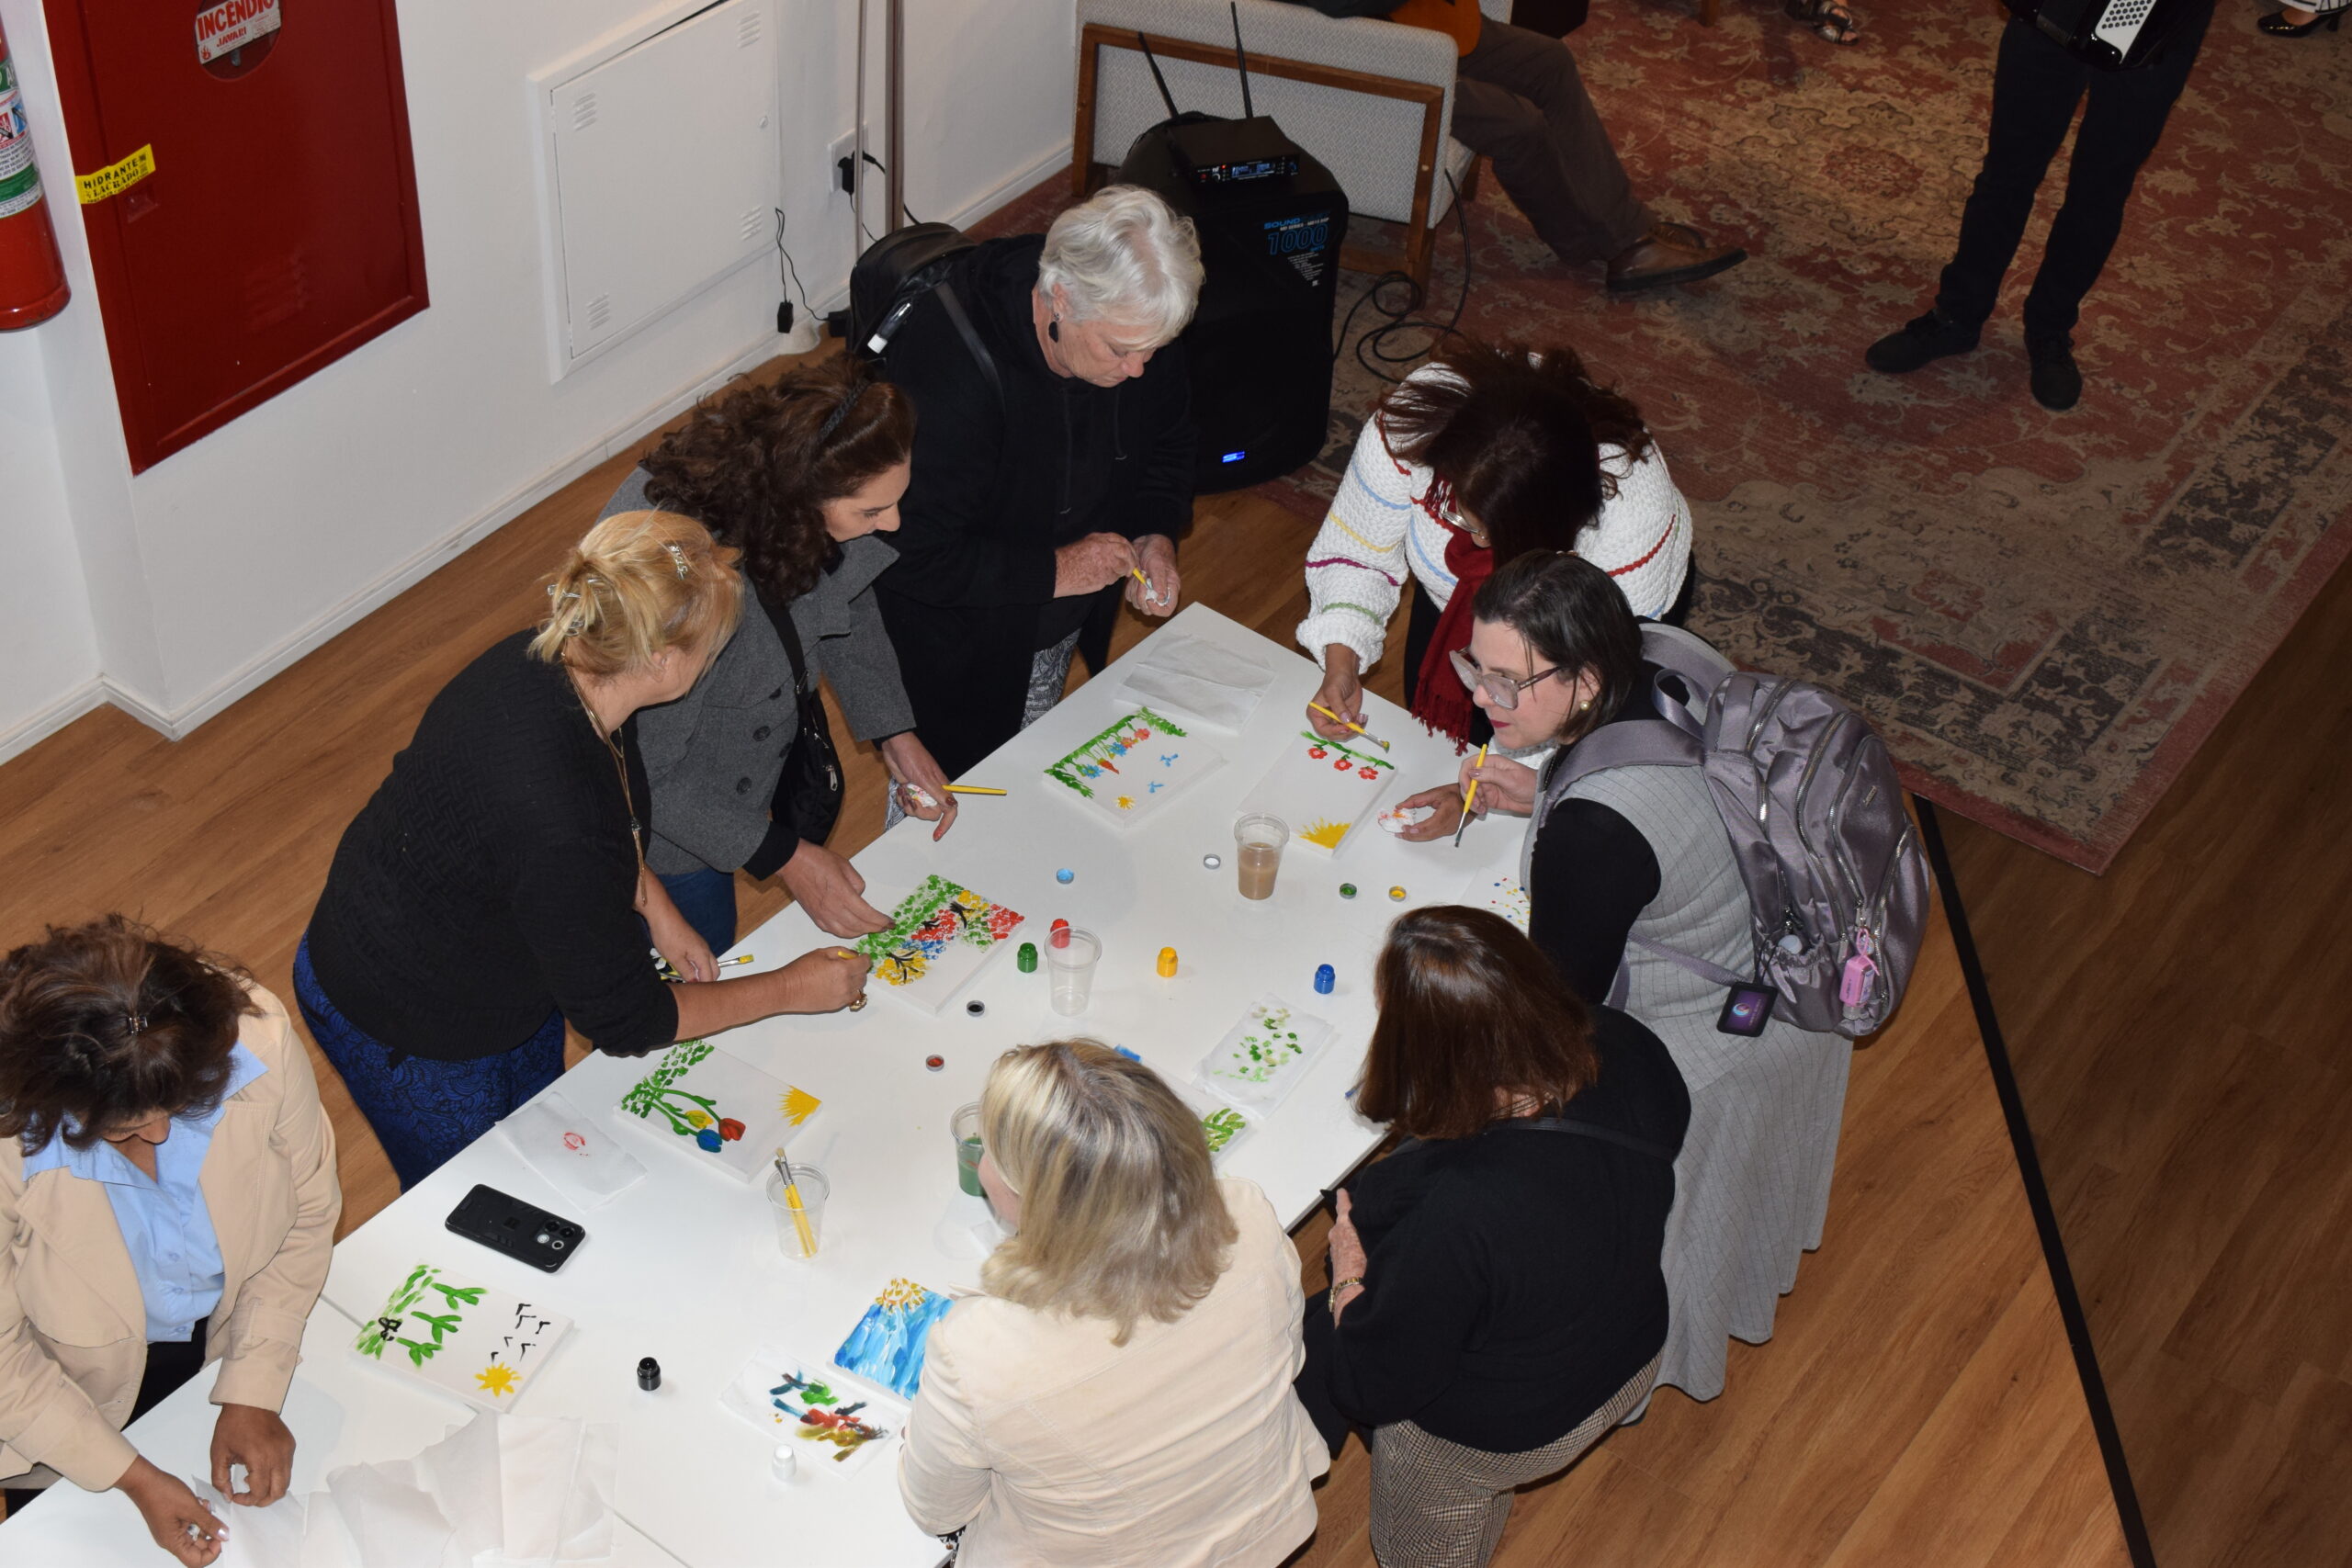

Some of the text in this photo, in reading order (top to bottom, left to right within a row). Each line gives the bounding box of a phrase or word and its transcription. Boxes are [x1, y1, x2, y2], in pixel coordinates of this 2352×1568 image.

[84, 159, 138, 188] HIDRANTE
[93, 169, 139, 197] LACRADO
[1268, 223, 1329, 255] 1000
